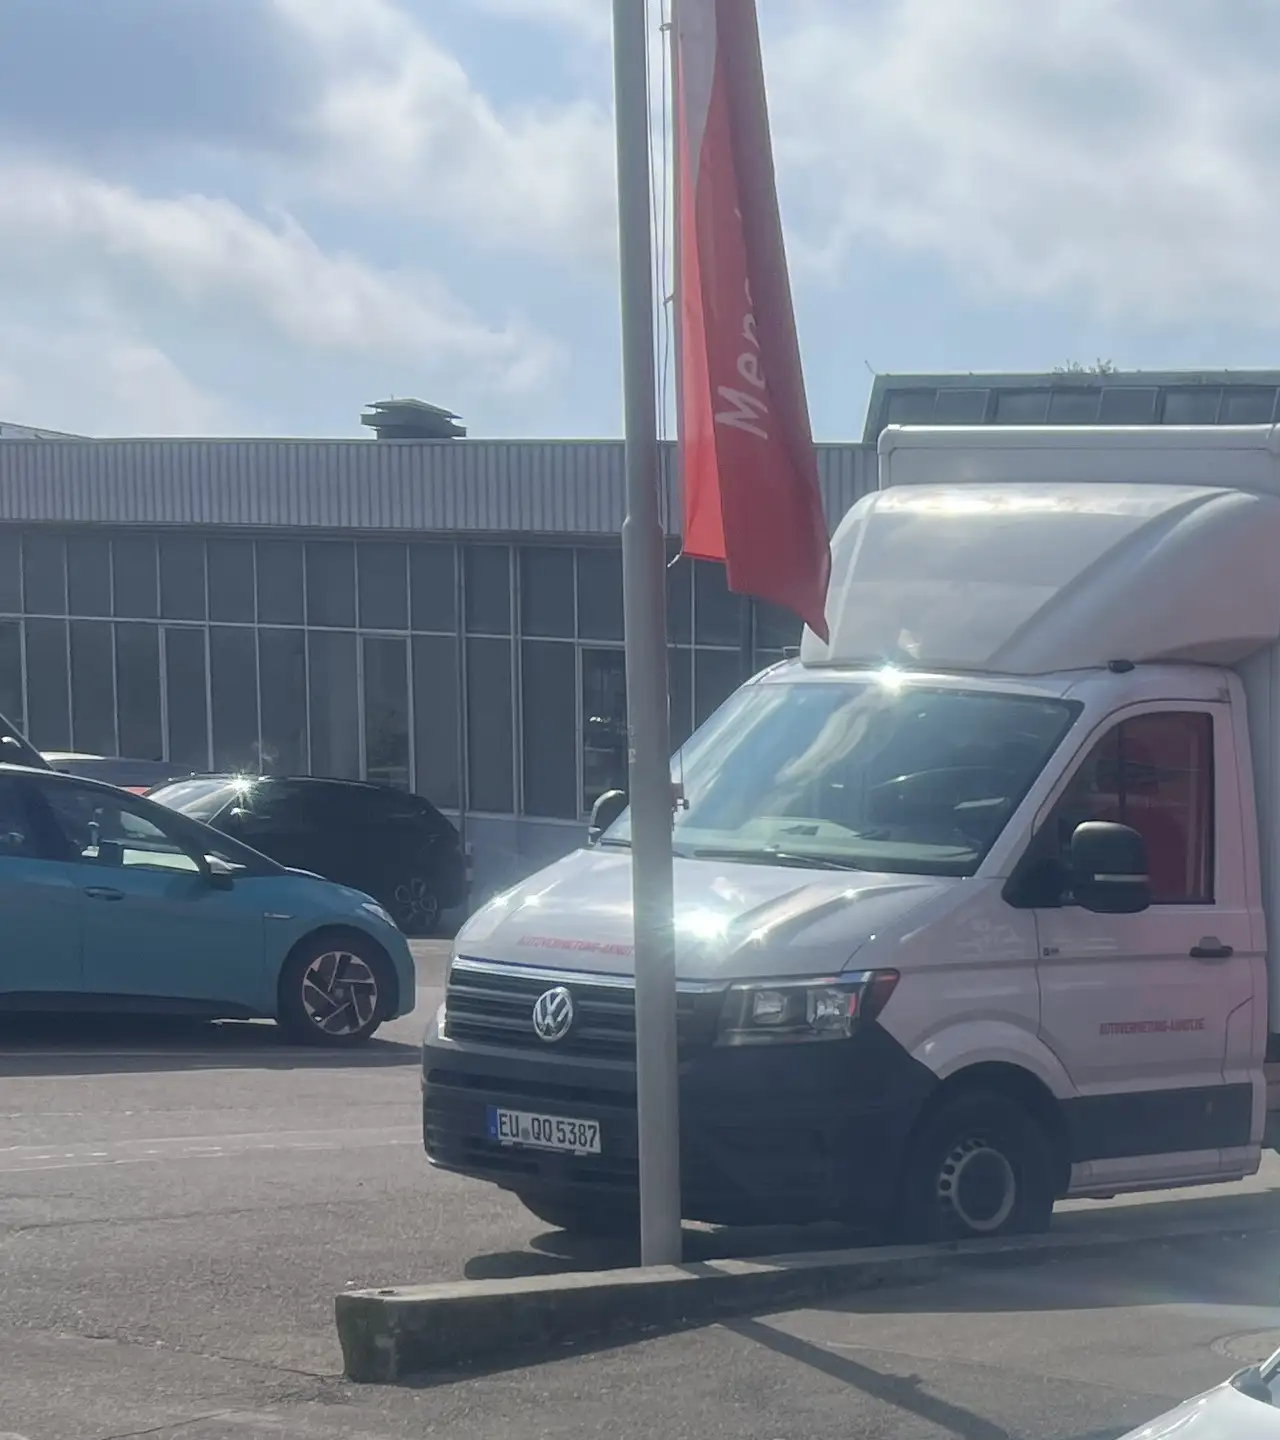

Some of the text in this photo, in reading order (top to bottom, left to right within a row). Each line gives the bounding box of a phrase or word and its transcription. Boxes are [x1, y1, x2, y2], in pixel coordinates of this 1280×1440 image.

[499, 1113, 597, 1148] EU QQ 5387
